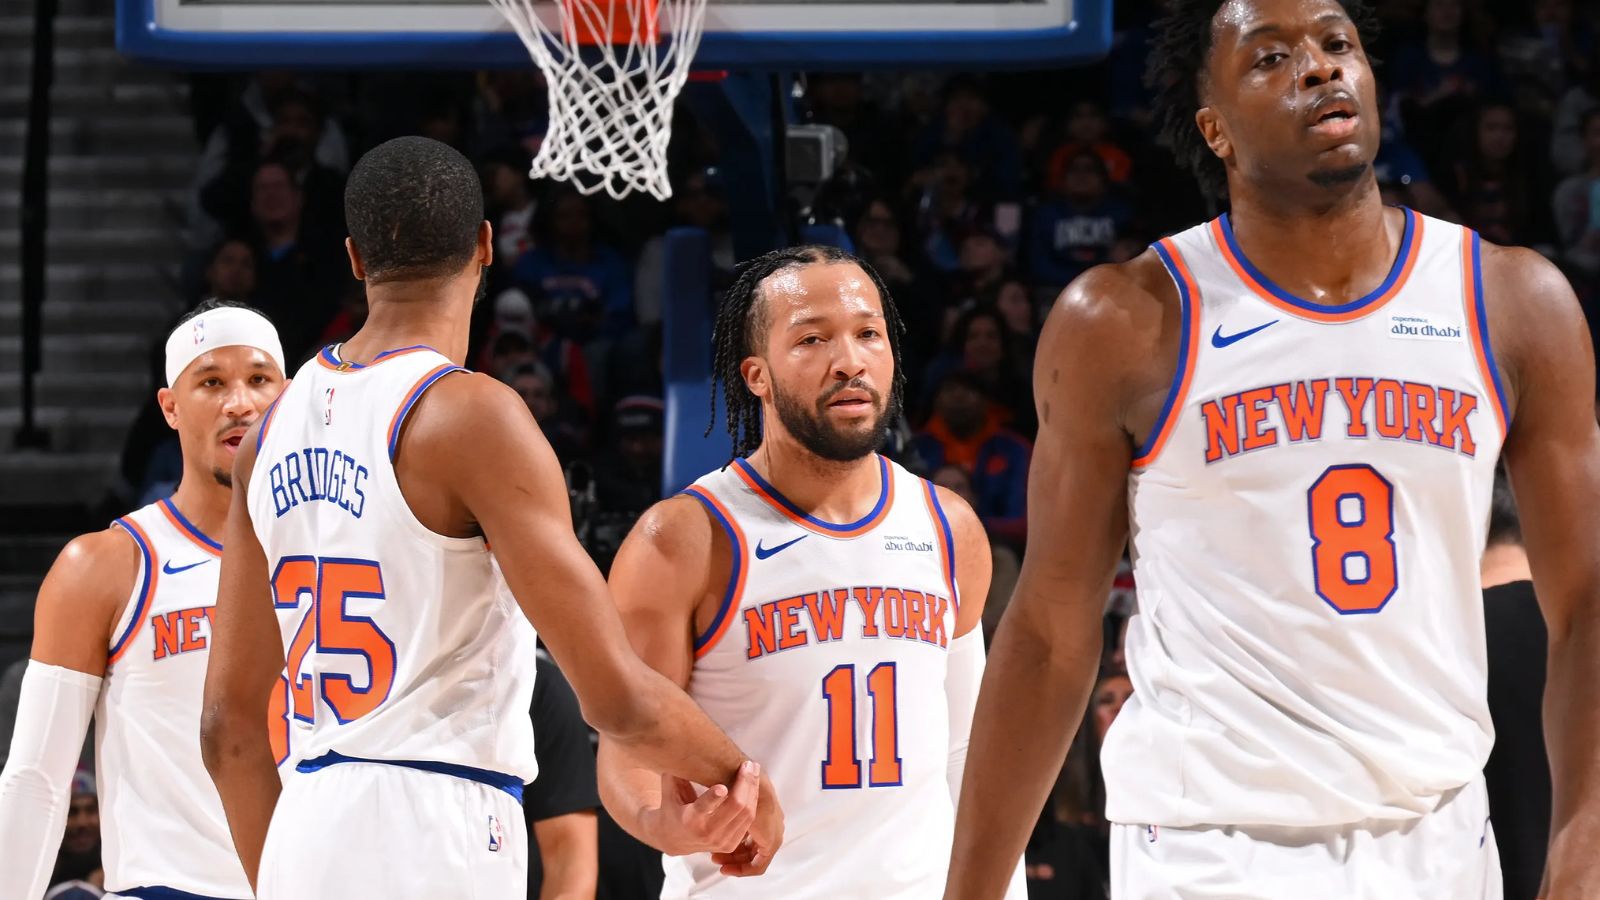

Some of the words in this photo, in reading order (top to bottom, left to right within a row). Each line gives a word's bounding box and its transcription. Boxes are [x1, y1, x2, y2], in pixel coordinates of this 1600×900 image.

[1391, 323, 1418, 335] abu
[1421, 324, 1461, 338] dhabi
[1201, 378, 1330, 464] NEW
[1334, 376, 1478, 459] YORK
[269, 446, 369, 519] BRIDGES
[884, 541, 903, 551] abu
[904, 541, 933, 552] dhabi
[1306, 463, 1399, 615] 8
[270, 554, 398, 726] 25
[743, 587, 849, 662] NEW
[852, 585, 949, 650] YORK
[821, 661, 903, 790] 11
